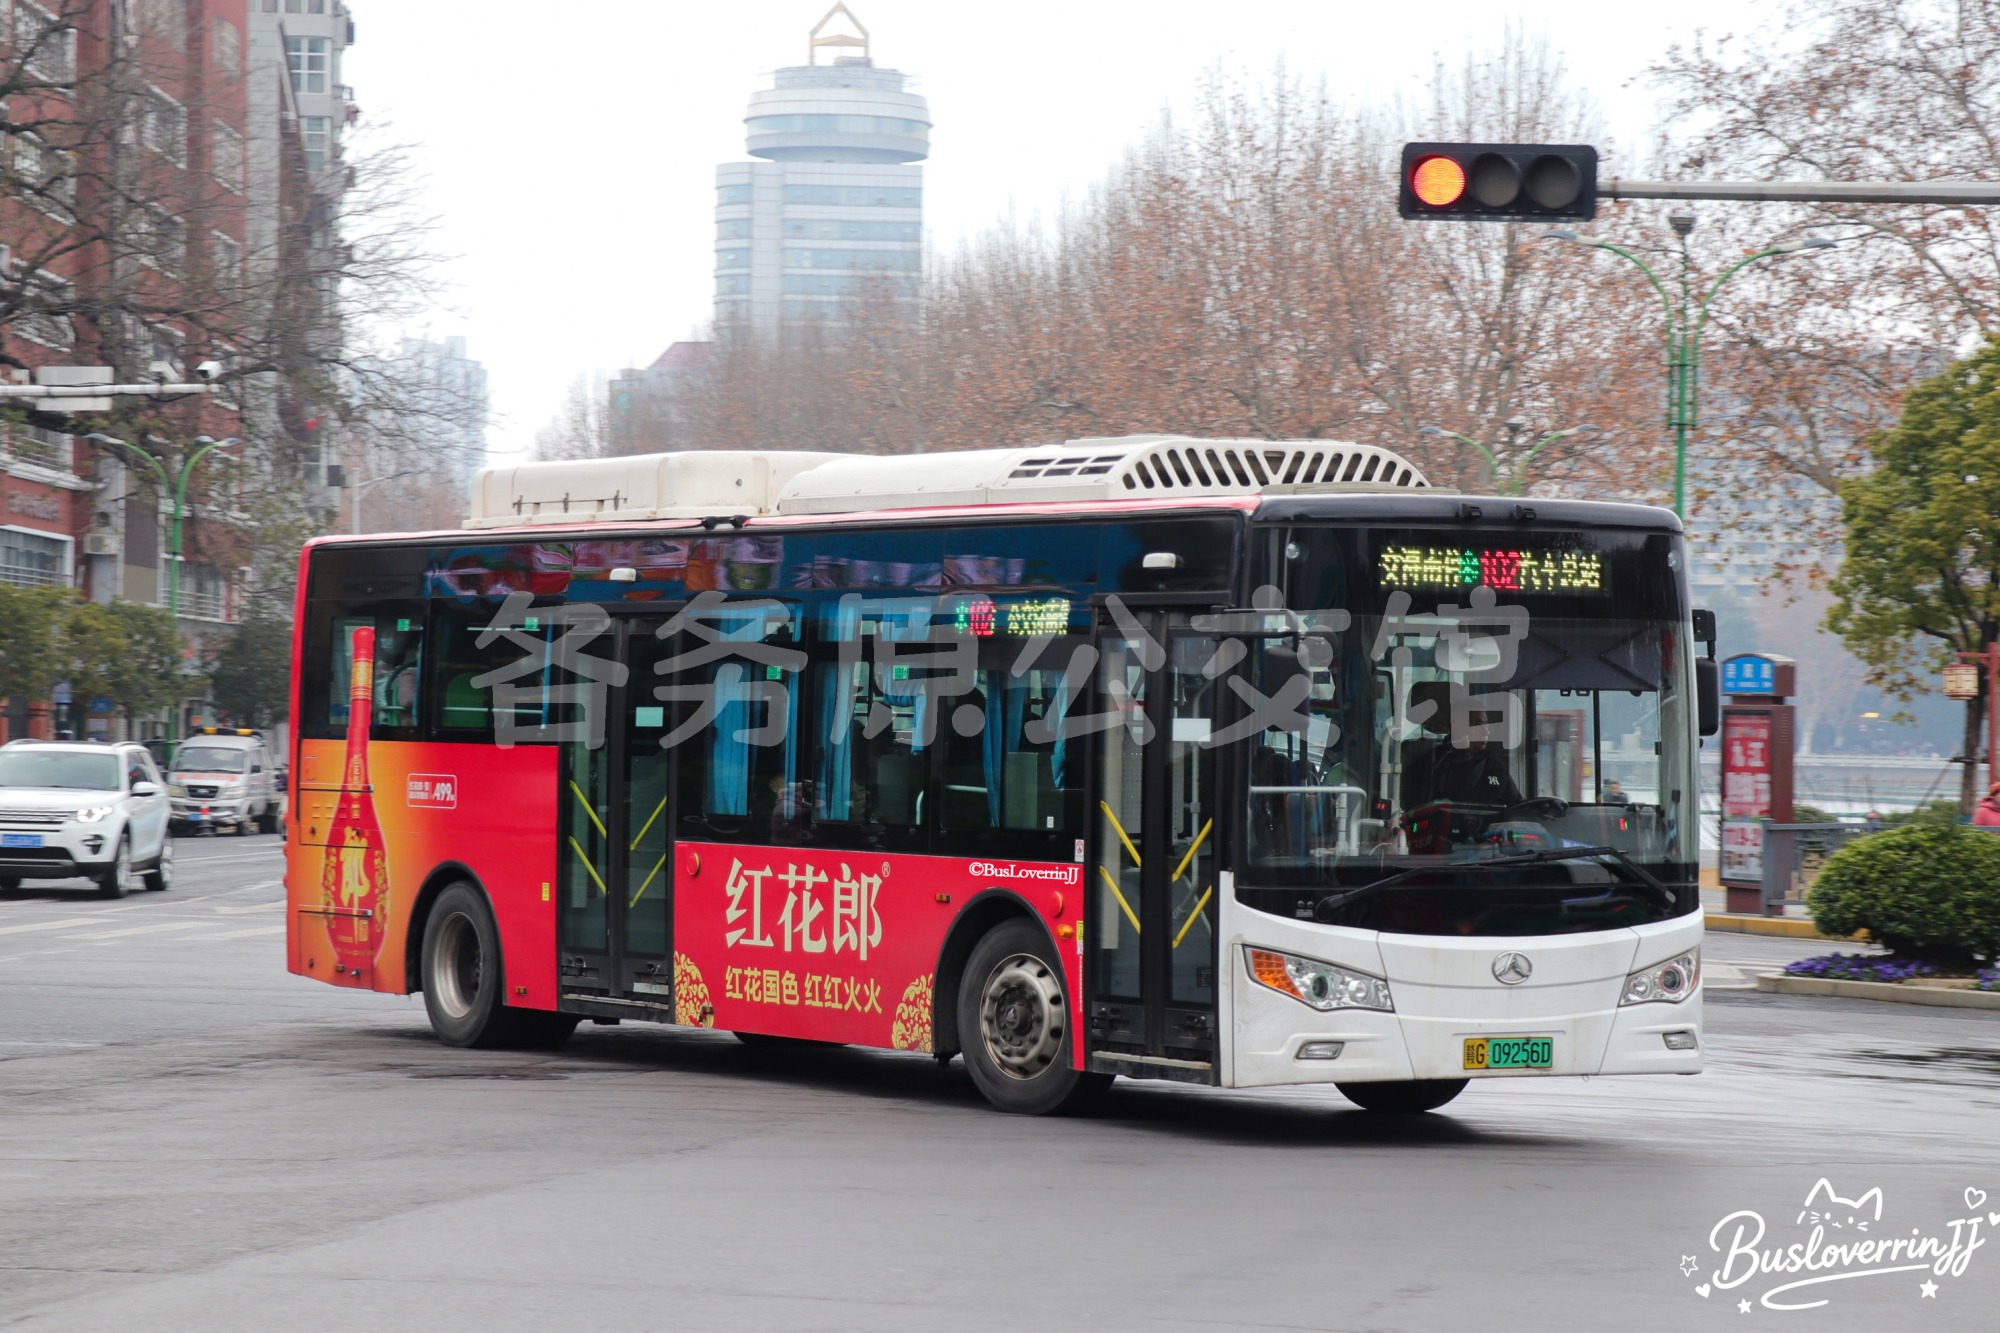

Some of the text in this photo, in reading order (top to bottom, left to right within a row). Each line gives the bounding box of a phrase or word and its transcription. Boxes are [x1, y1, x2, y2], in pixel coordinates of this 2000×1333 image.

[1480, 550, 1520, 588] 102
[725, 857, 883, 961] 红花郎
[725, 965, 882, 1014] 红花国色 红红火火
[1492, 1041, 1551, 1064] 09256D
